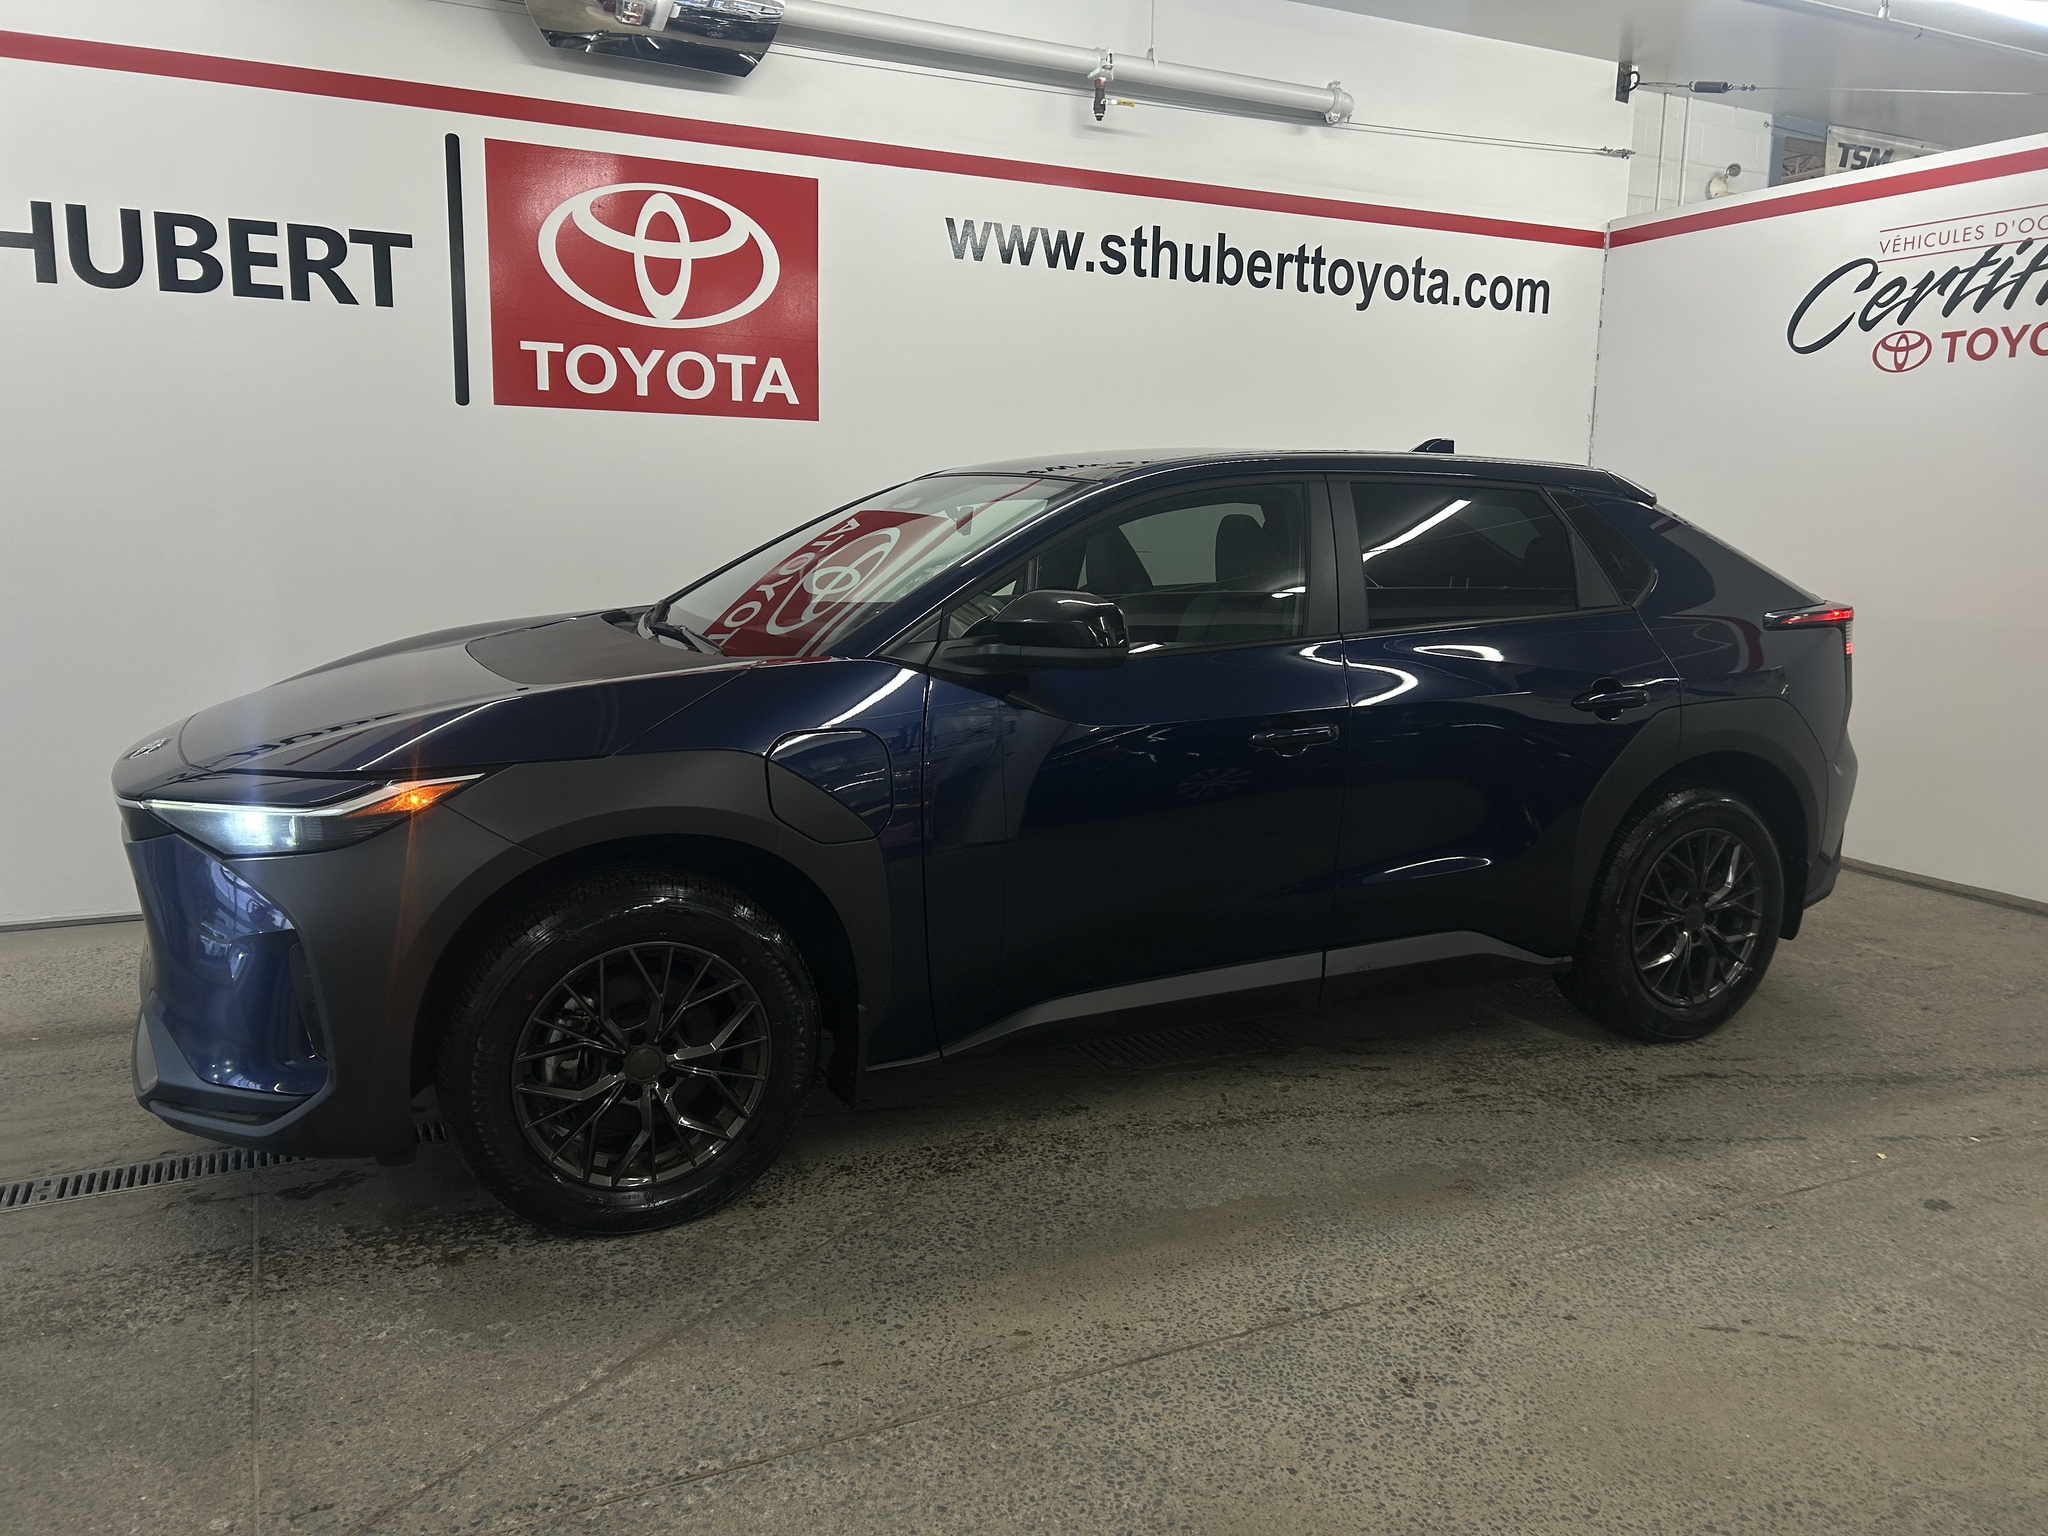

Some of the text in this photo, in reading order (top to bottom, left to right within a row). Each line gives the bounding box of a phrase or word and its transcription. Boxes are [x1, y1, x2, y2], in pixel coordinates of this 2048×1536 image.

[1838, 142, 1894, 170] TSM
[1879, 224, 1985, 255] VÉHICULES
[945, 217, 1551, 314] www.sthuberttoyota.com
[519, 340, 800, 405] TOYOTA
